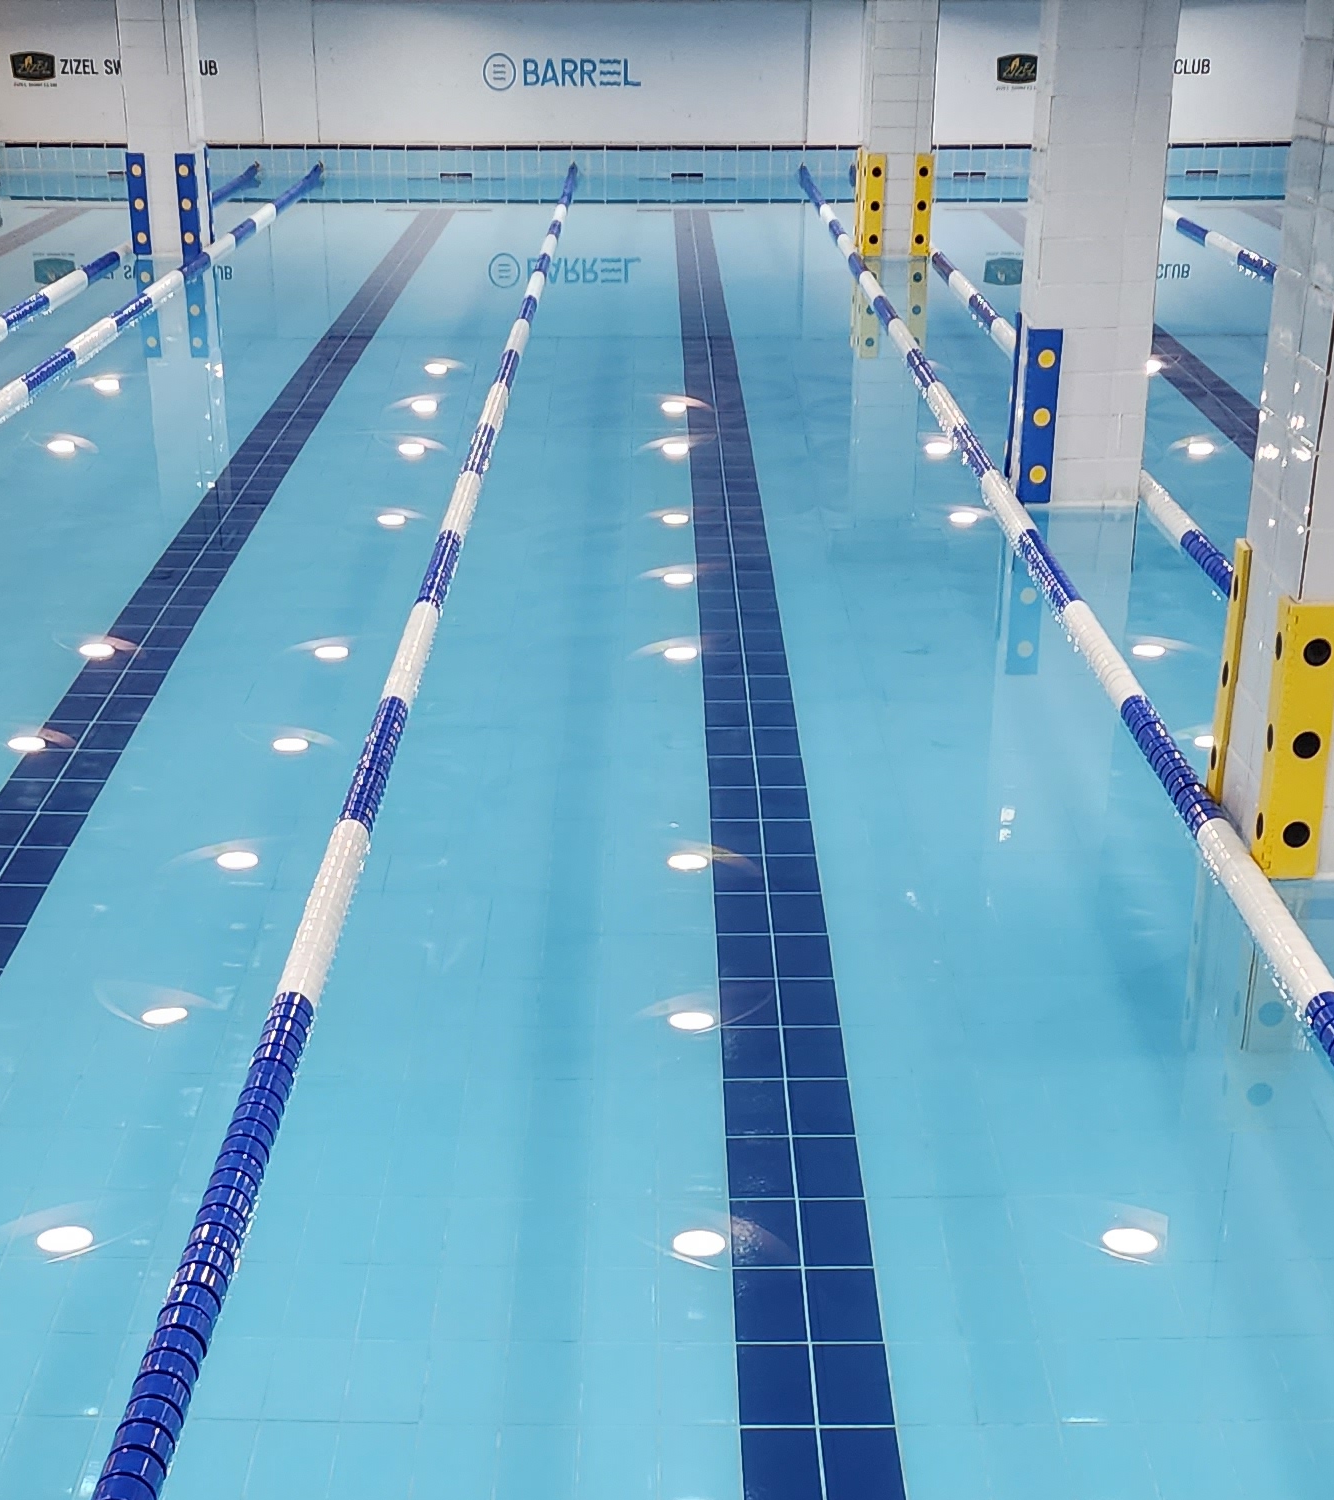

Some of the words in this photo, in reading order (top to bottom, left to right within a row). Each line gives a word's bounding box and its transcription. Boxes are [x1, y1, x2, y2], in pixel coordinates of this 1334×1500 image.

[60, 59, 99, 75] ZIZEL
[199, 59, 218, 76] UB
[522, 58, 642, 87] BARREL
[1173, 58, 1211, 75] CLUB
